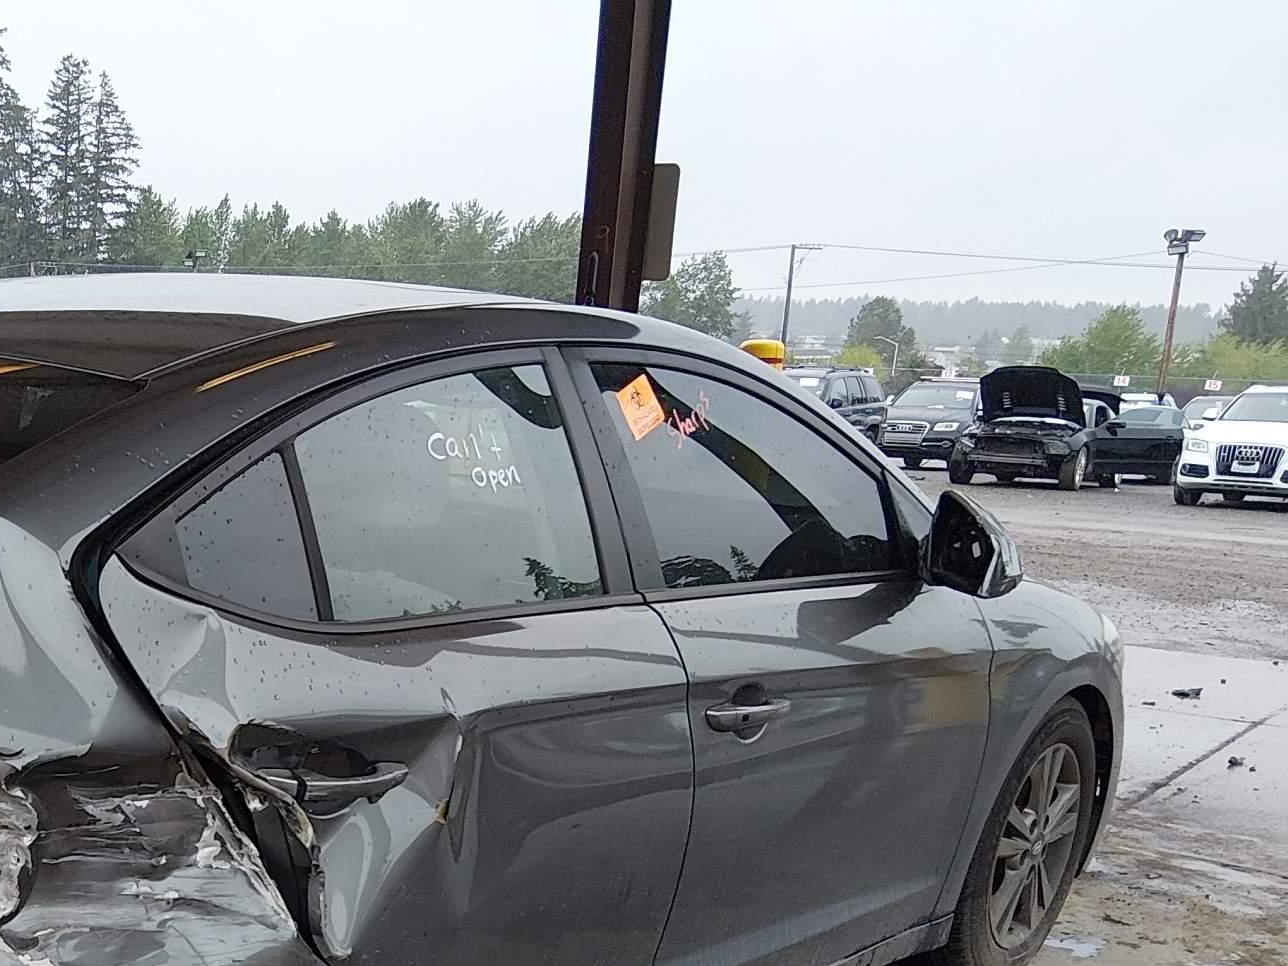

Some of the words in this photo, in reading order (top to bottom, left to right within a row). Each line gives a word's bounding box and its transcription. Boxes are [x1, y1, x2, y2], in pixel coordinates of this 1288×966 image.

[1118, 377, 1127, 385] 14
[1210, 381, 1220, 390] 15
[427, 423, 502, 461] Can't
